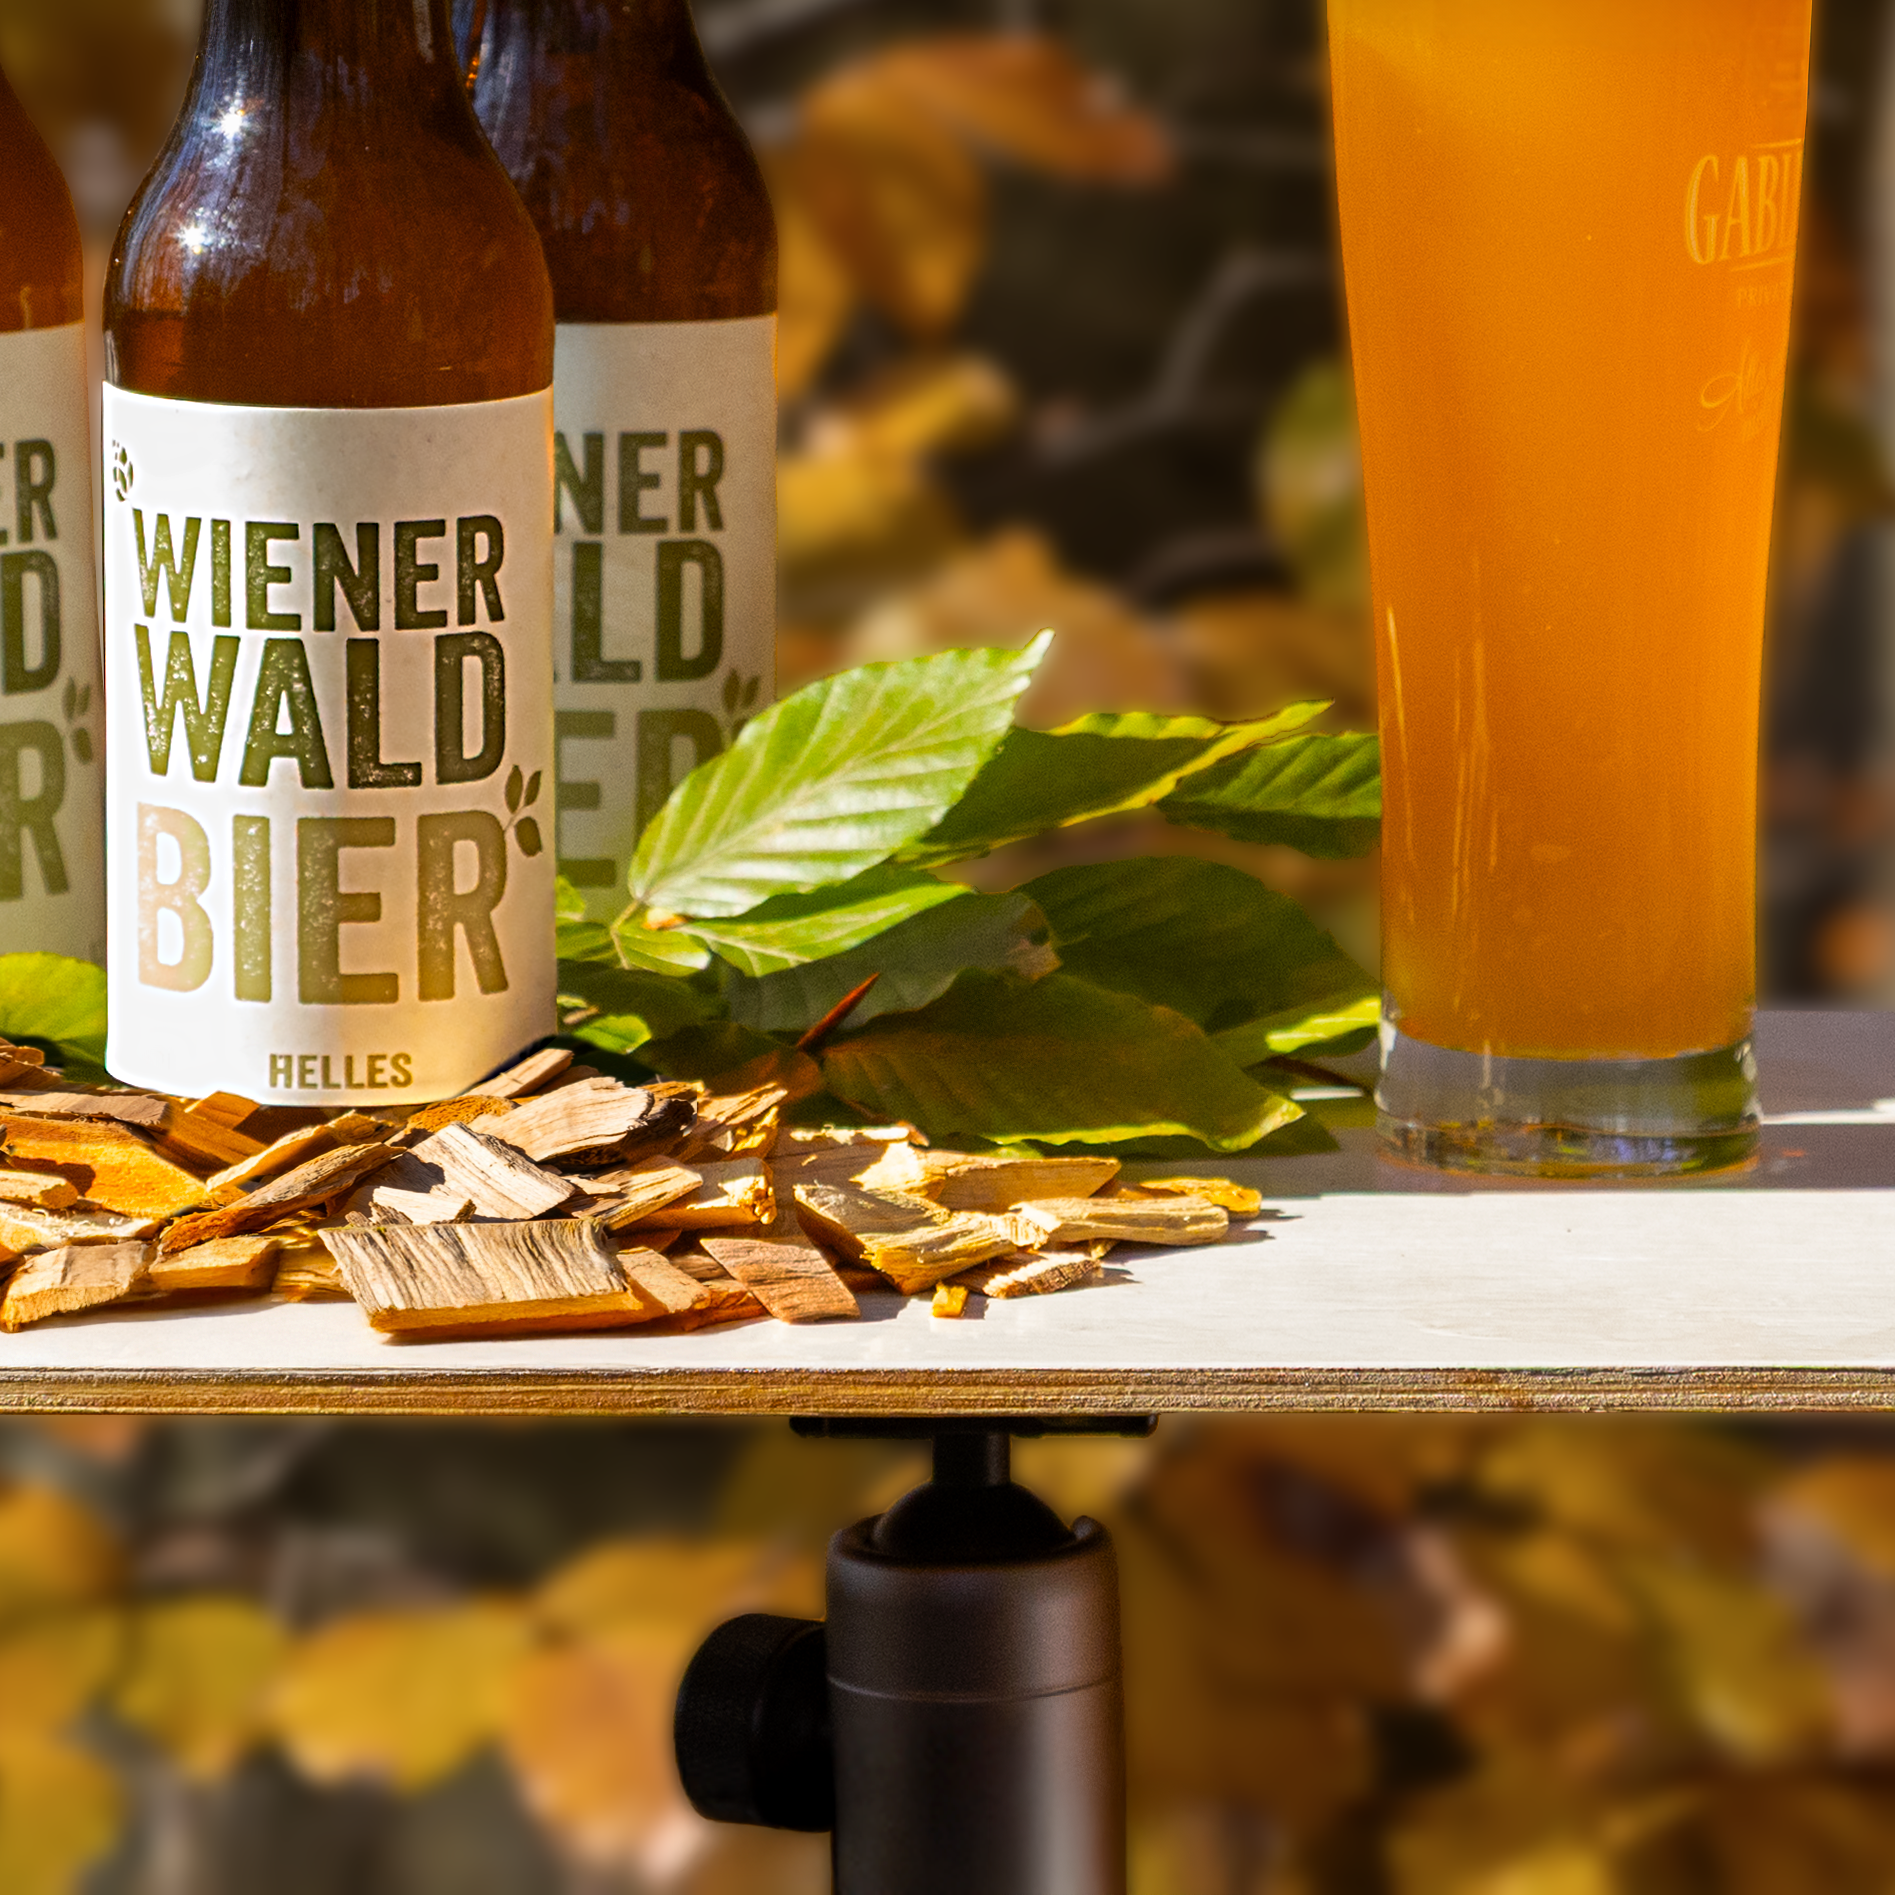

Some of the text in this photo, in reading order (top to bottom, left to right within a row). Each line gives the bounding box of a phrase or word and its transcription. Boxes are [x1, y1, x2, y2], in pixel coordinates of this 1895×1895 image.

[132, 508, 505, 632] WIENER
[554, 540, 725, 685] LD
[134, 624, 506, 789] WALD
[137, 802, 509, 1005] BIER
[268, 1052, 414, 1090] HELLES
